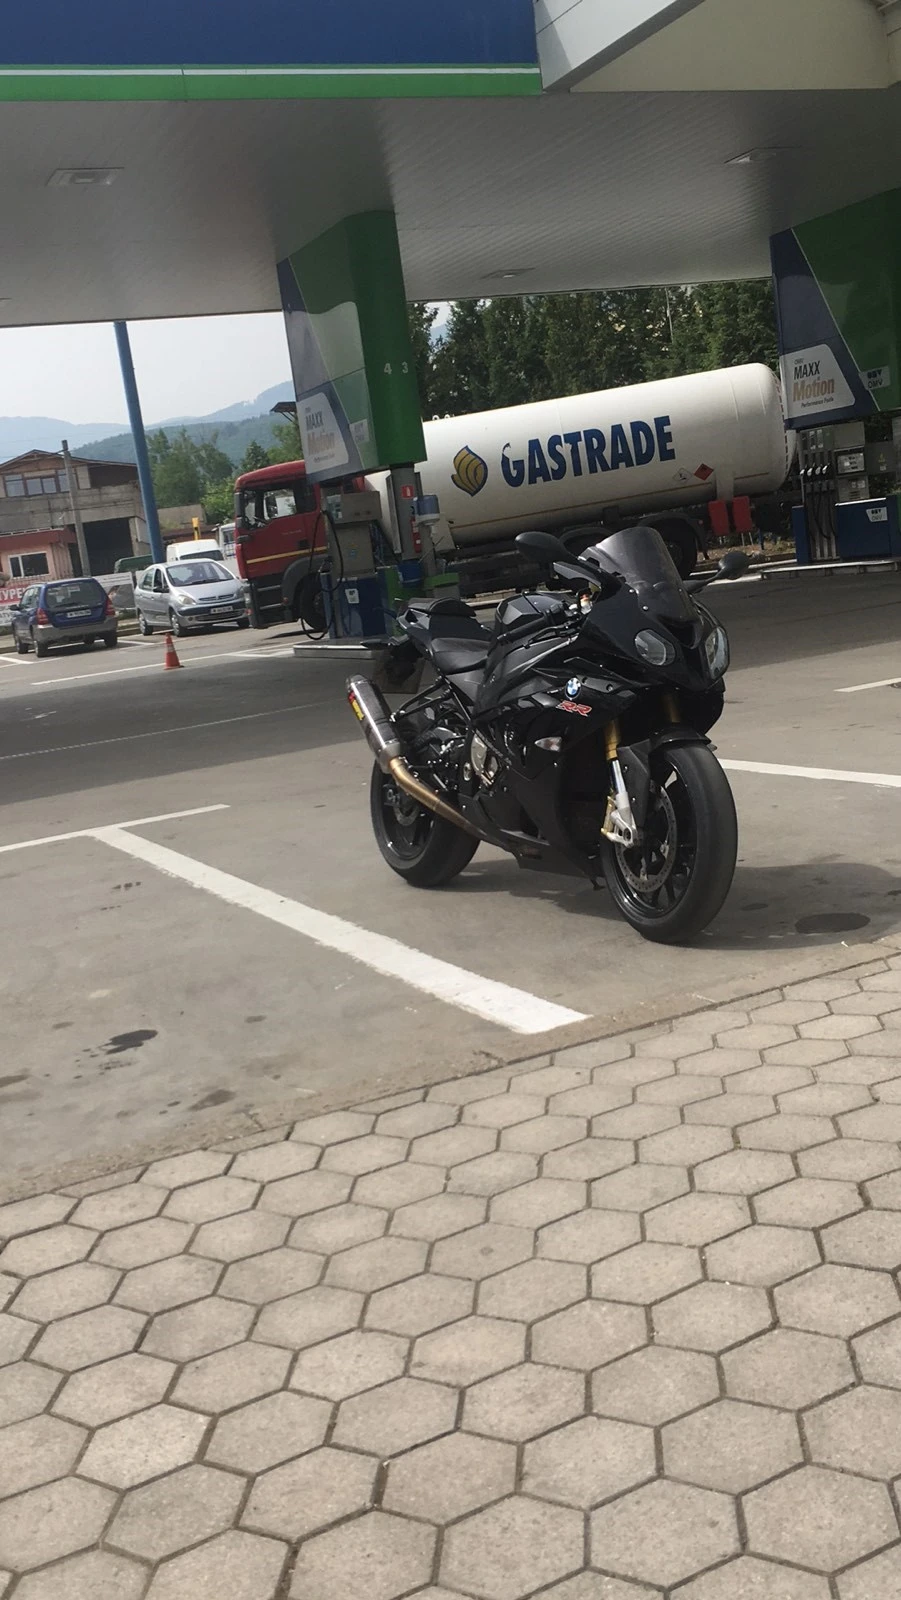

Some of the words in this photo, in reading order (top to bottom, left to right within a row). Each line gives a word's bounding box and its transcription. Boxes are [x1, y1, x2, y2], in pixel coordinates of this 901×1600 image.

[383, 362, 393, 375] 4
[401, 360, 409, 374] 3
[794, 360, 821, 380] MAXX
[793, 376, 835, 402] Motion
[868, 378, 883, 388] OMV
[306, 410, 324, 431] MAXX
[501, 415, 675, 487] GASTRADE
[556, 700, 592, 717] RR
